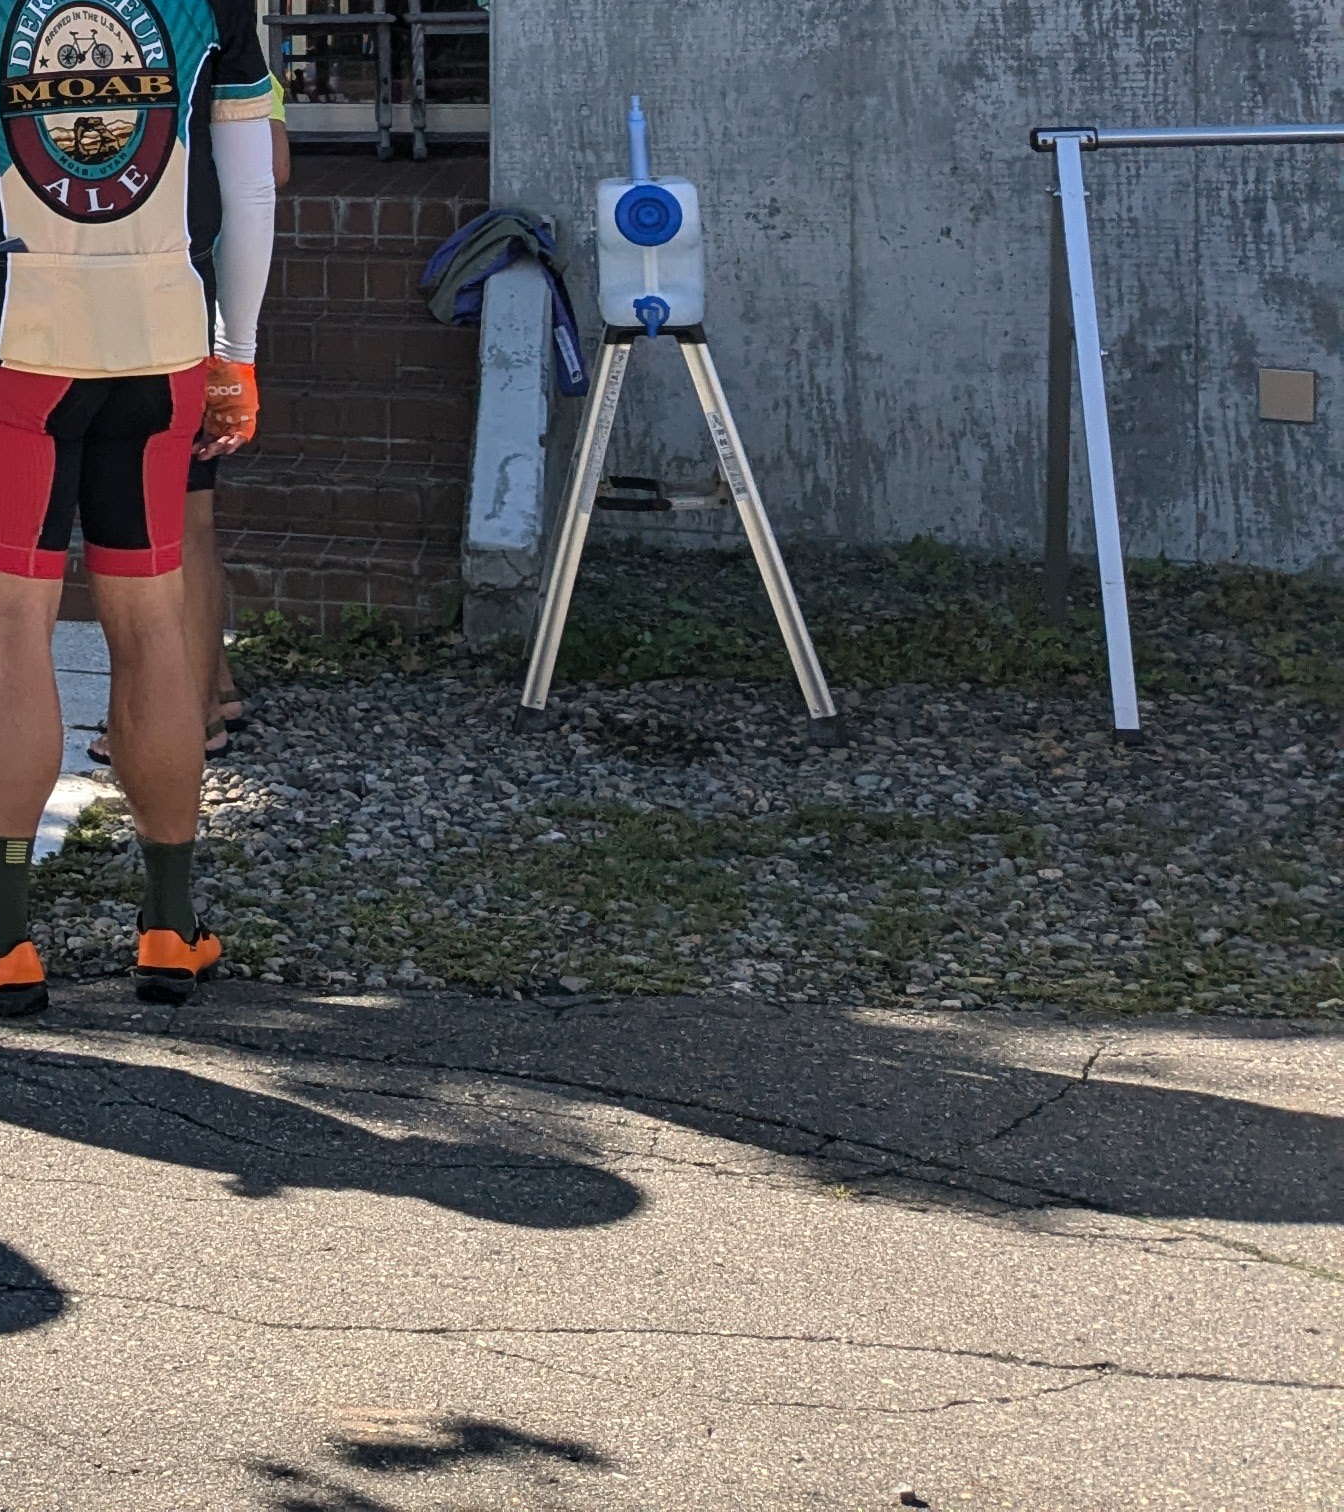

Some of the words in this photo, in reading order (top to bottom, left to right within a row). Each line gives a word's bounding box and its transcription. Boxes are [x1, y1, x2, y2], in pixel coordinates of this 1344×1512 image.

[45, 15, 71, 47] BREWED
[8, 75, 173, 104] MOAB
[99, 153, 127, 175] UTAH
[43, 164, 149, 213] ALE
